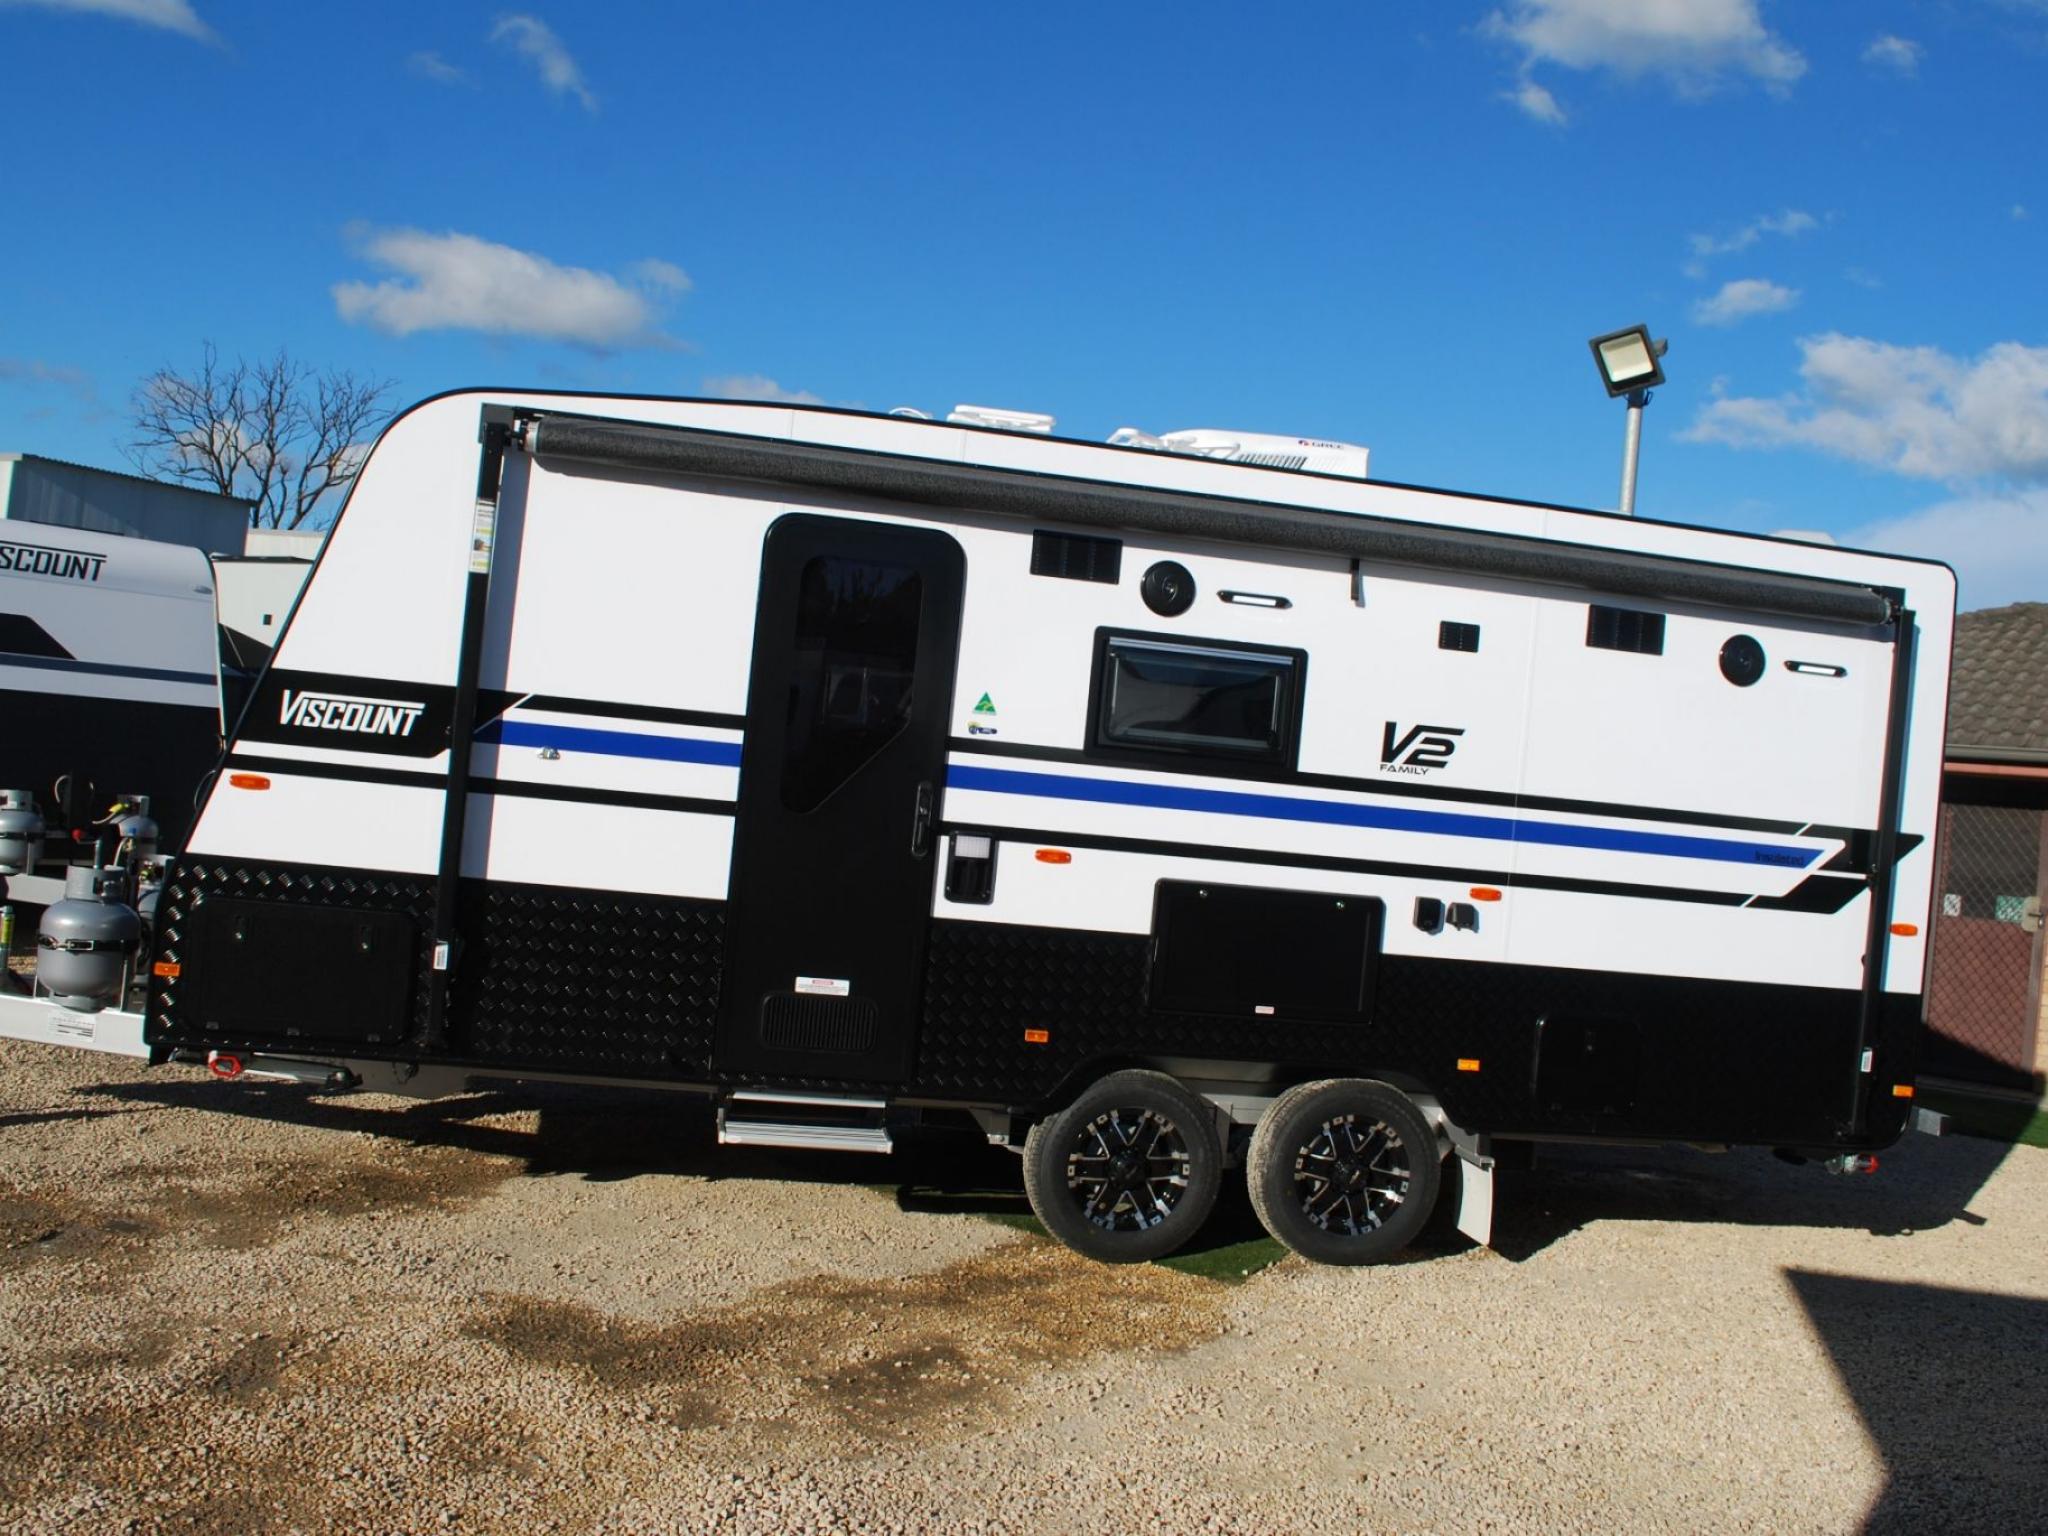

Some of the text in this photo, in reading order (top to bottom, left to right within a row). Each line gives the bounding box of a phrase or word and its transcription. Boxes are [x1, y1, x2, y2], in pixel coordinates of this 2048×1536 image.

[280, 689, 426, 737] VISCOUNT
[1381, 721, 1465, 769] V2
[1380, 764, 1429, 775] FAMILY
